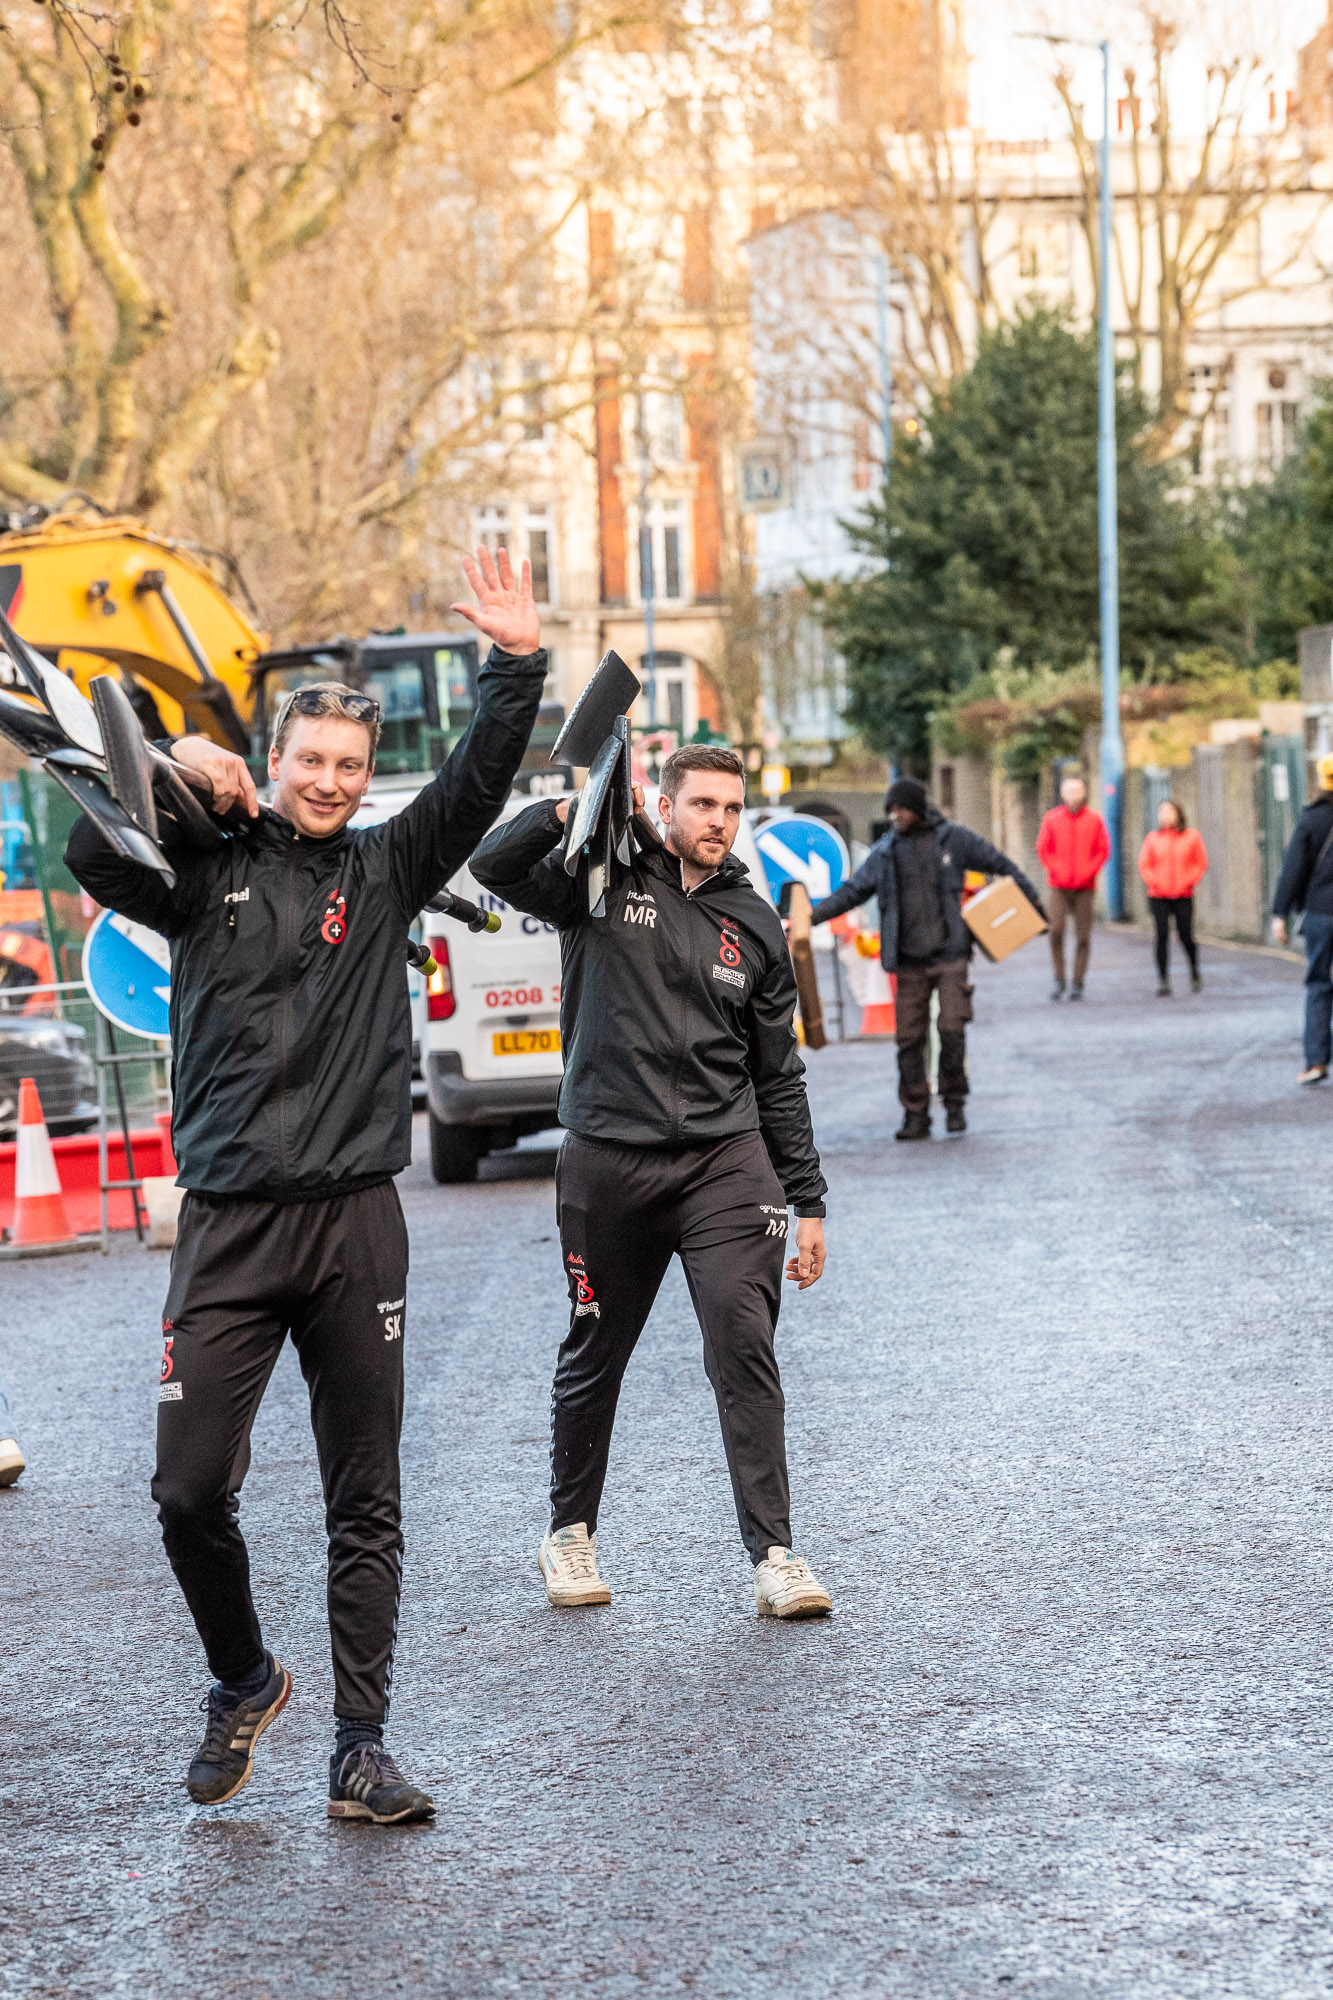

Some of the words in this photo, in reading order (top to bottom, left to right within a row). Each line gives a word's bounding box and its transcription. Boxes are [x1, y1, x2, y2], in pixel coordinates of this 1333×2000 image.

[623, 904, 658, 929] MR
[485, 986, 543, 1008] 0208
[499, 1031, 552, 1053] LL70
[384, 1313, 401, 1341] SK
